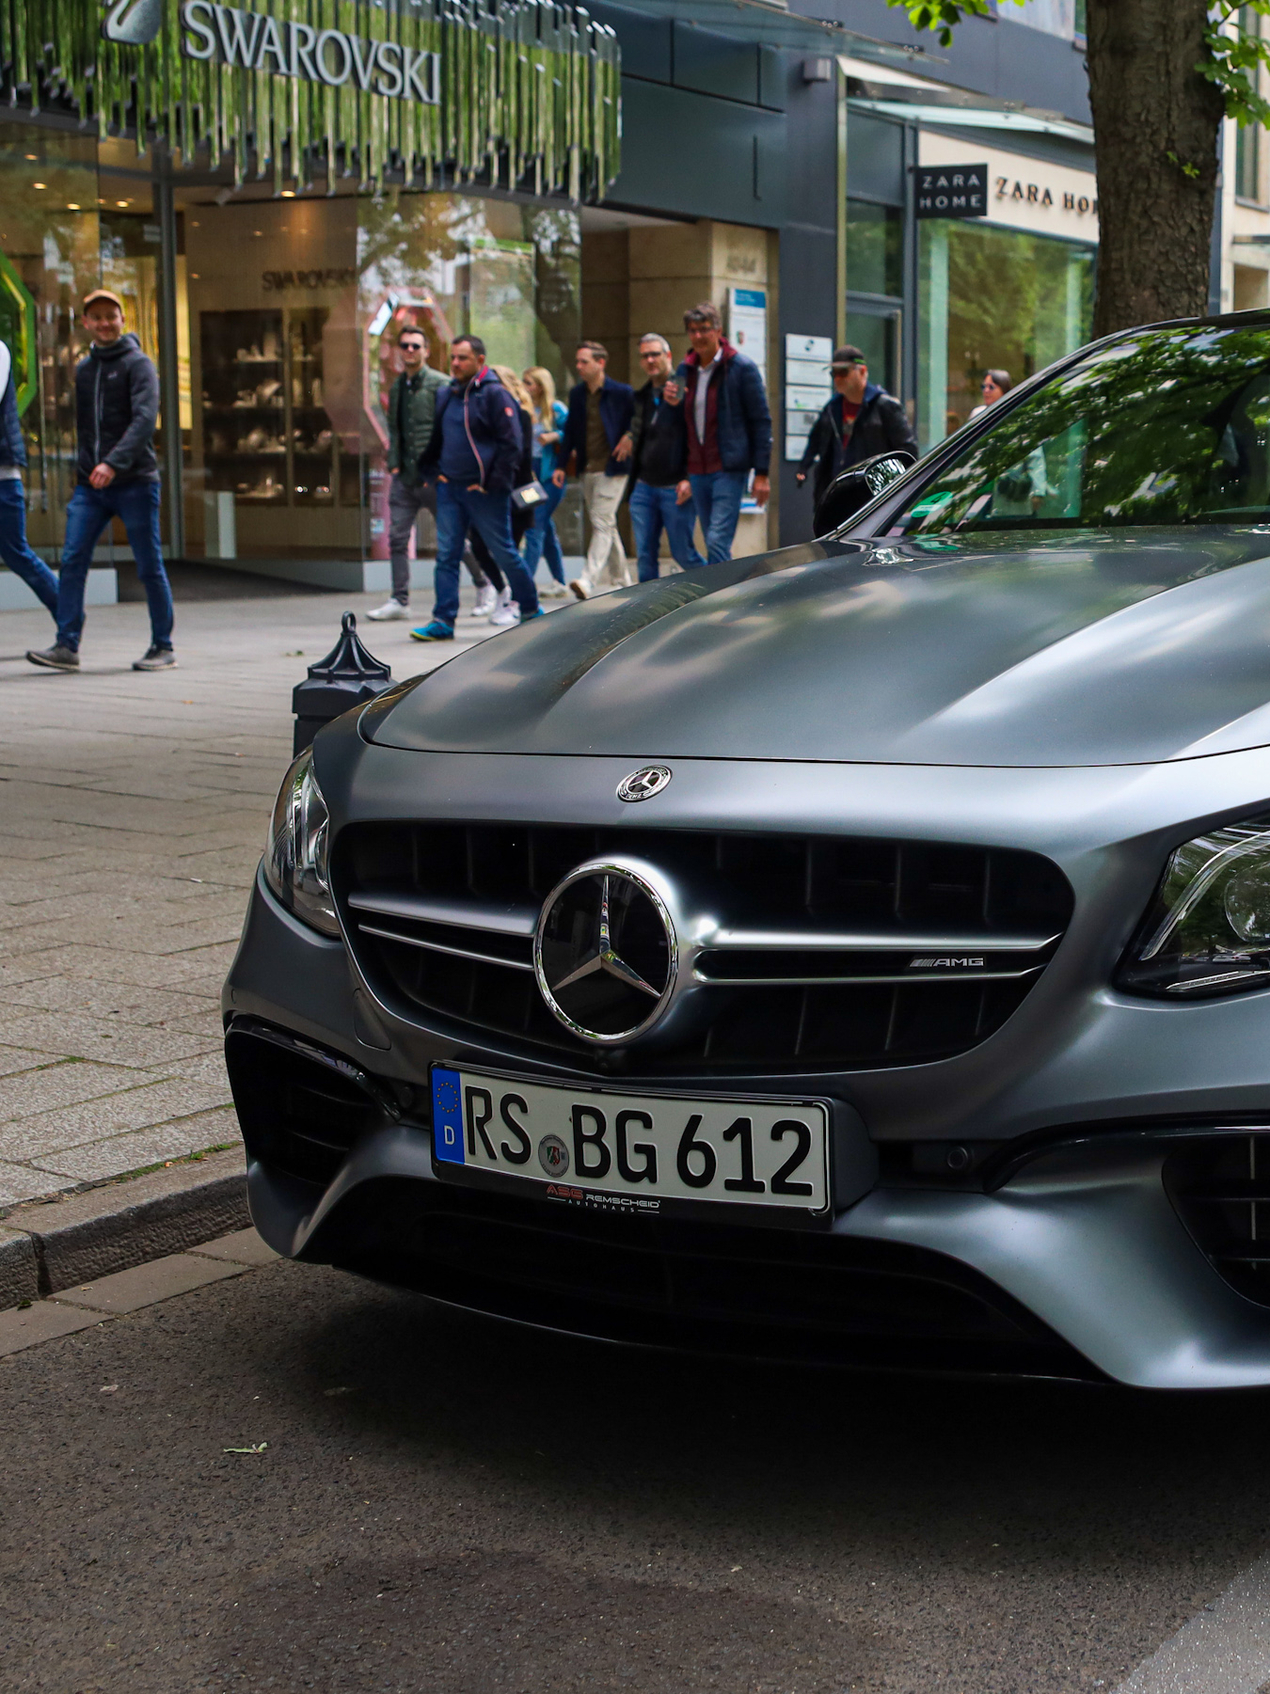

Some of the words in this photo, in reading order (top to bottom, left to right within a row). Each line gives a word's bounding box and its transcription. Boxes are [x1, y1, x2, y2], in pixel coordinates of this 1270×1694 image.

[181, 0, 441, 105] SWAROVSKI
[922, 173, 981, 189] ZARA
[997, 177, 1053, 206] ZARA
[919, 194, 982, 210] HOME
[933, 957, 984, 967] AMG
[444, 1124, 455, 1146] D
[465, 1085, 532, 1165] RS
[571, 1103, 659, 1184] BG
[676, 1113, 814, 1197] 612
[546, 1184, 583, 1200] ASG
[586, 1193, 660, 1209] REMSCHEID
[568, 1199, 635, 1214] AUTOHAUS
